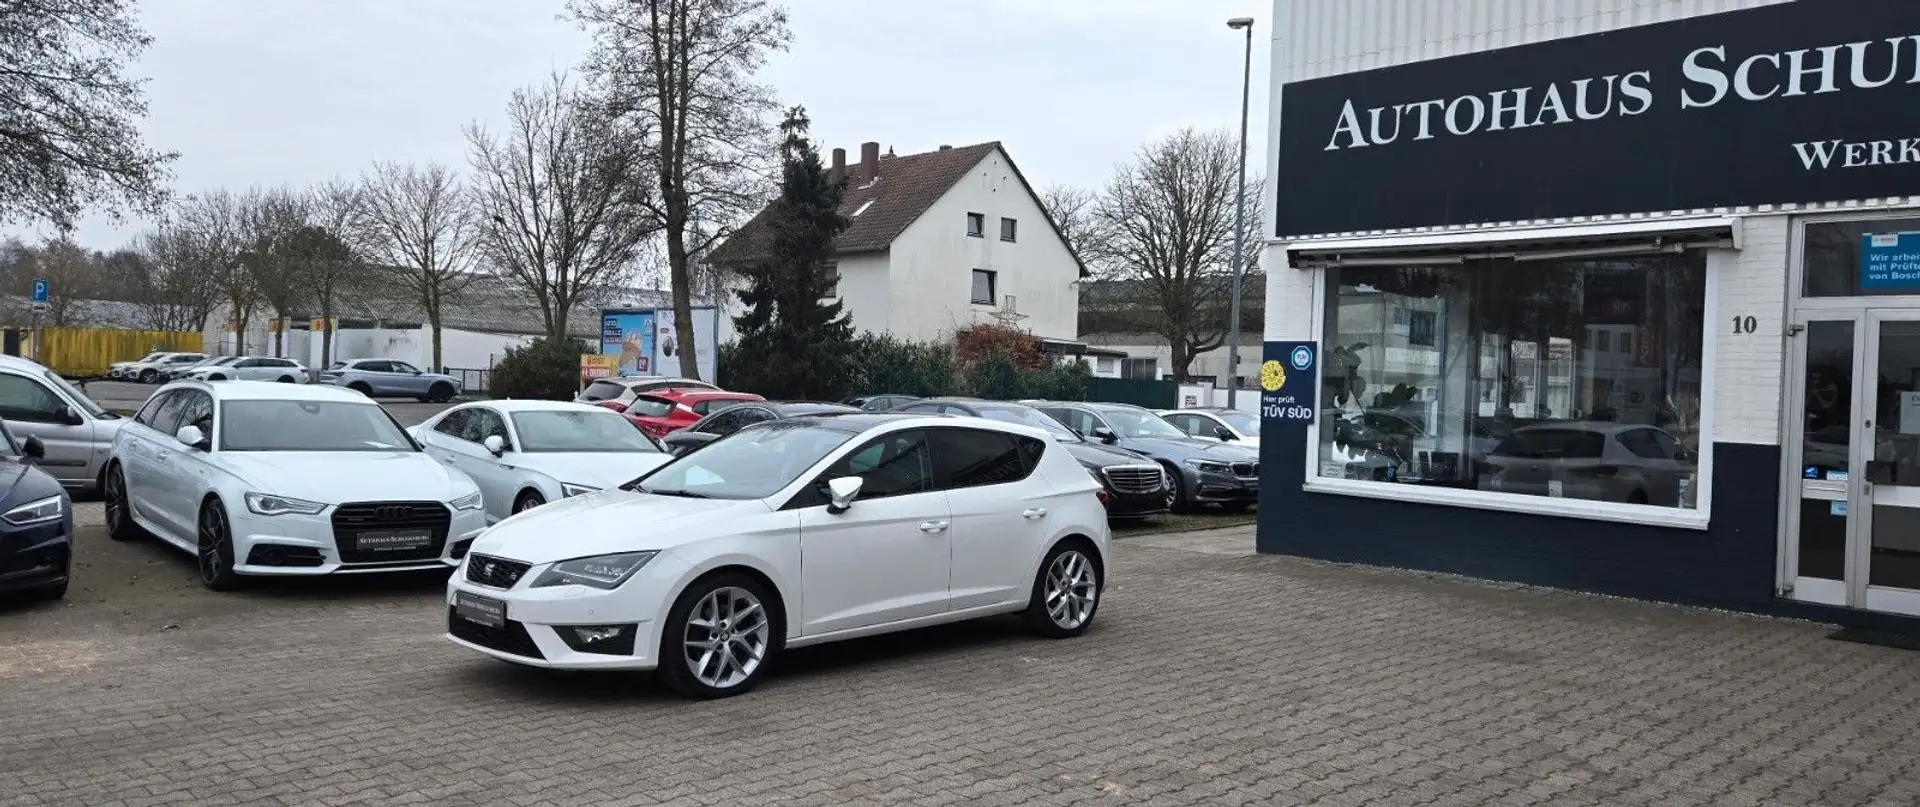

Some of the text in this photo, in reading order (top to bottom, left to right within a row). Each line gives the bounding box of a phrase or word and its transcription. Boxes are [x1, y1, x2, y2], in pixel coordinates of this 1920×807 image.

[1324, 70, 1653, 151] AUTOHAUS
[1870, 253, 1889, 262] Wir
[1870, 263, 1887, 271] mit
[35, 282, 45, 299] P
[1732, 315, 1757, 334] 10
[1263, 395, 1296, 405] Hier prüft
[1262, 404, 1312, 419] TÜV SÜD
